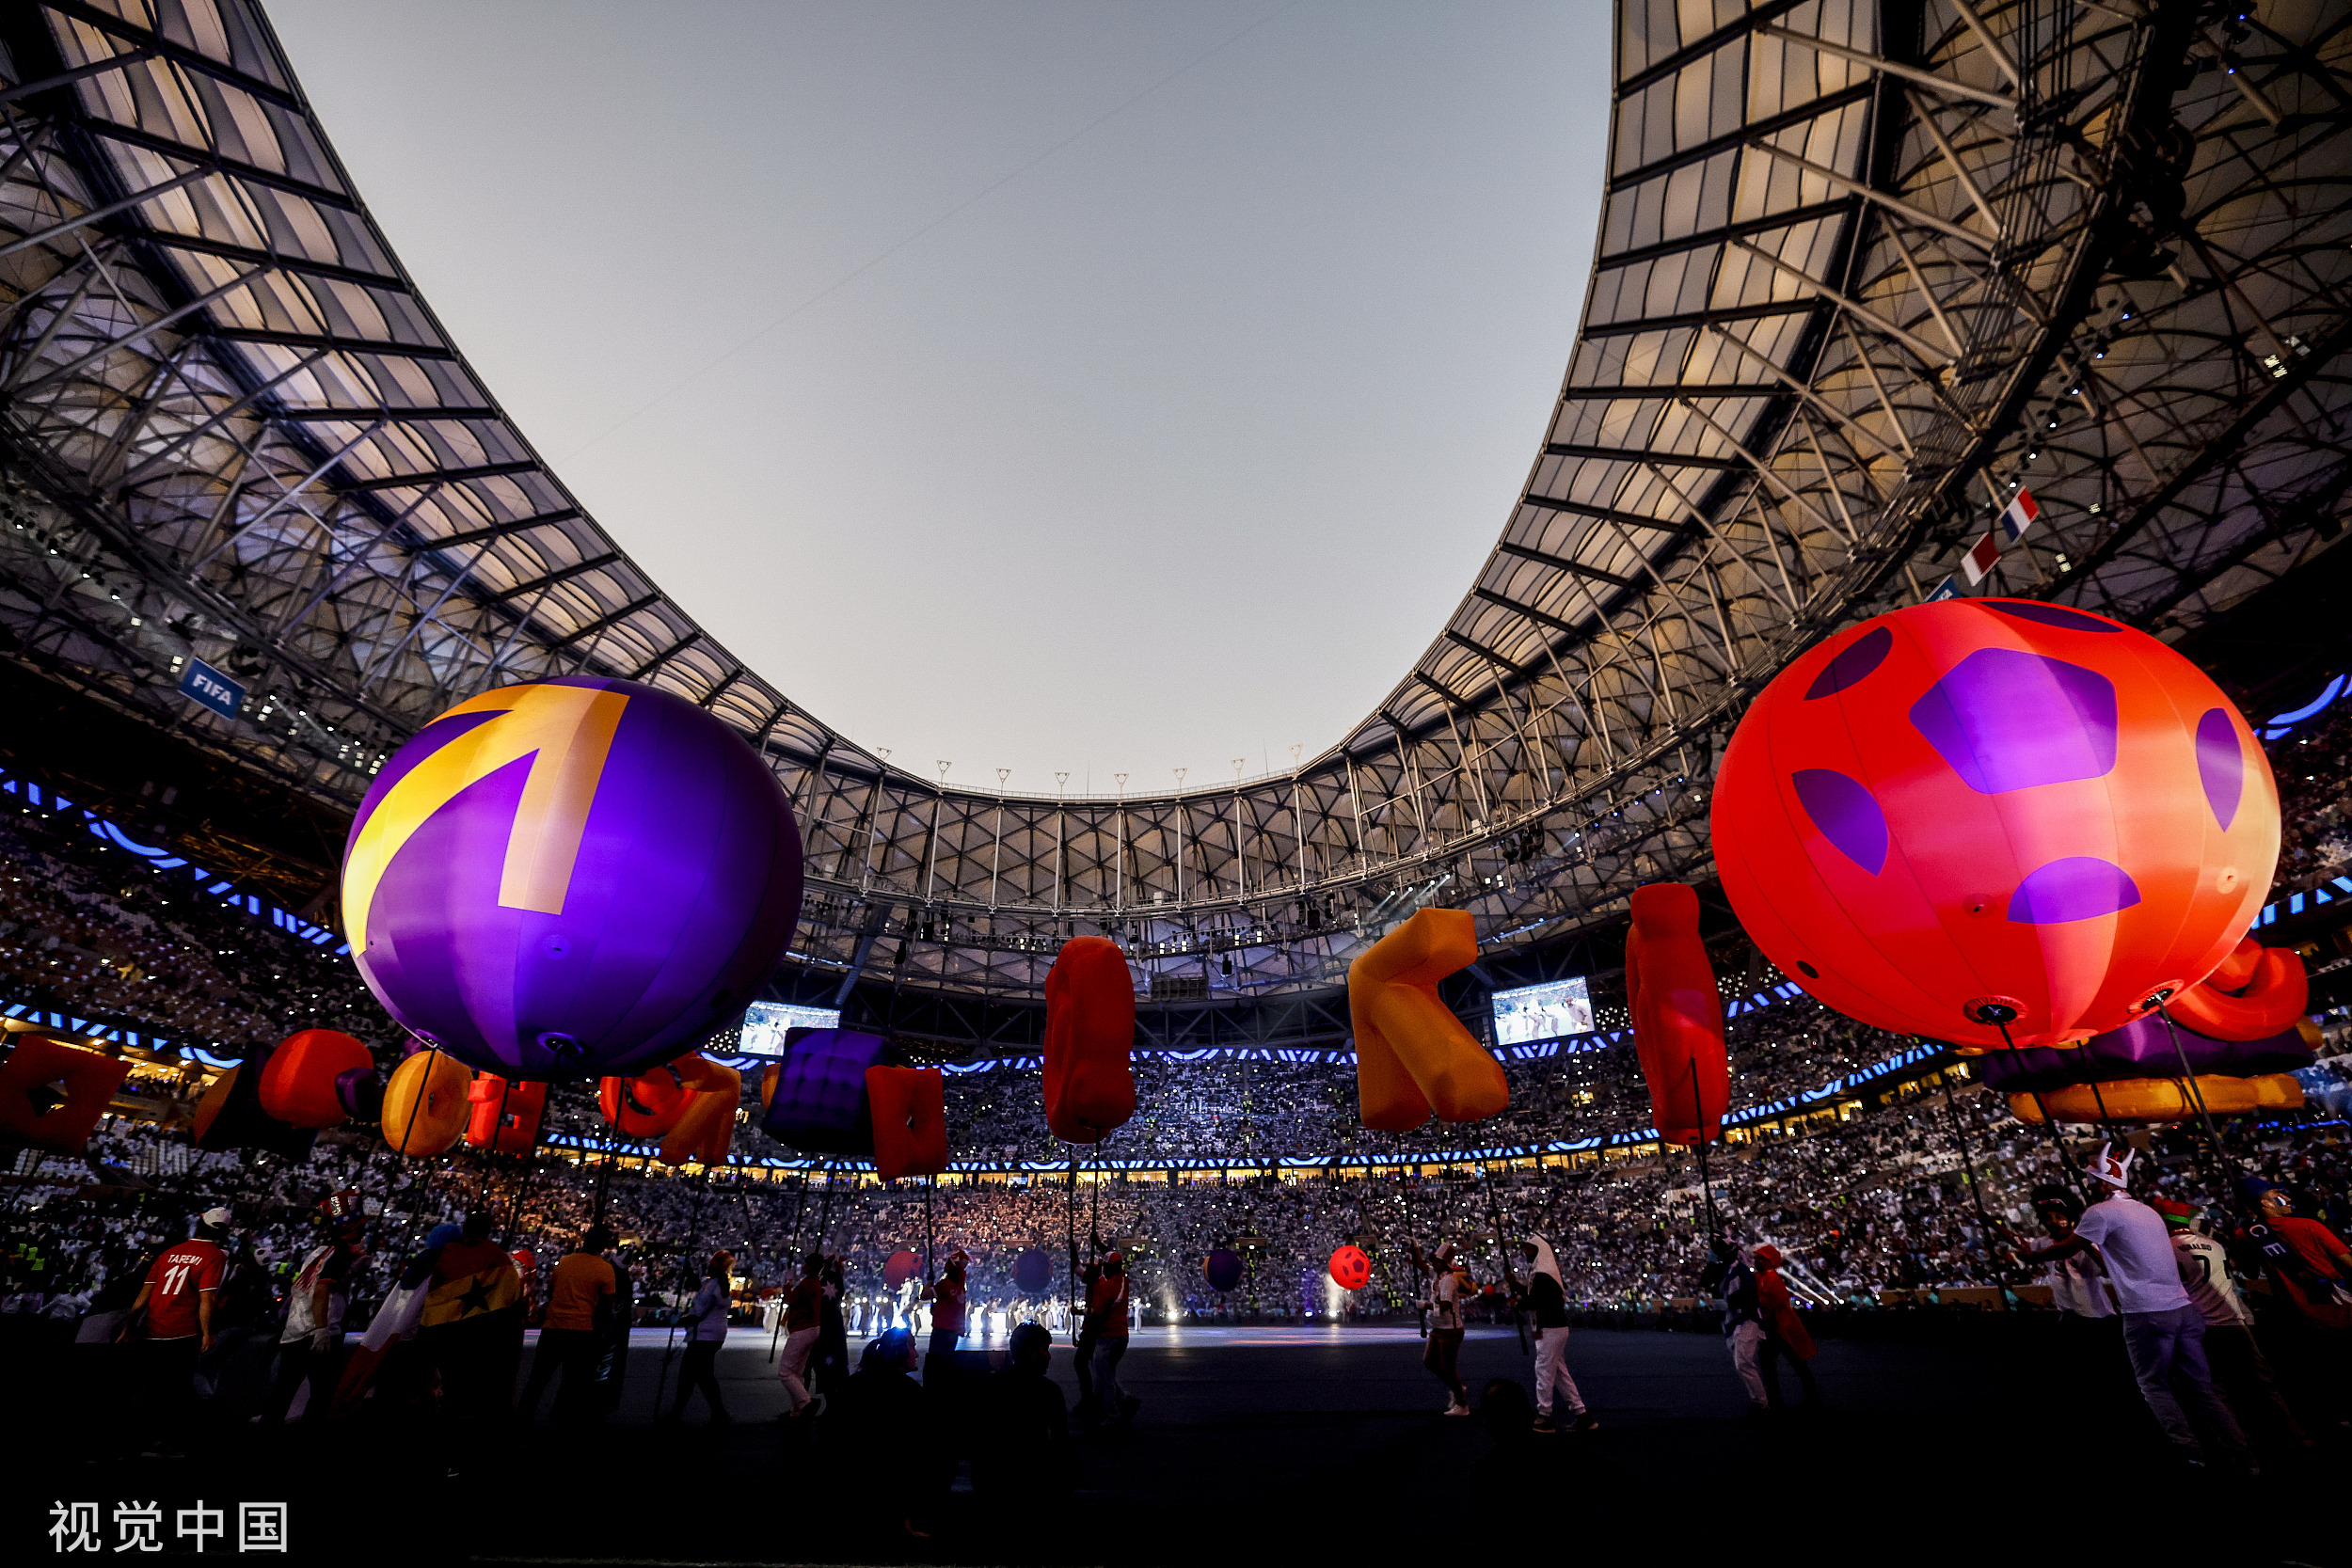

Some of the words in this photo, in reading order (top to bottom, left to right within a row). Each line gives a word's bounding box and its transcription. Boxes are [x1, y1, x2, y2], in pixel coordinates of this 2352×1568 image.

[192, 673, 231, 705] FIFA
[167, 1254, 203, 1266] TAREMI
[161, 1265, 191, 1295] 11
